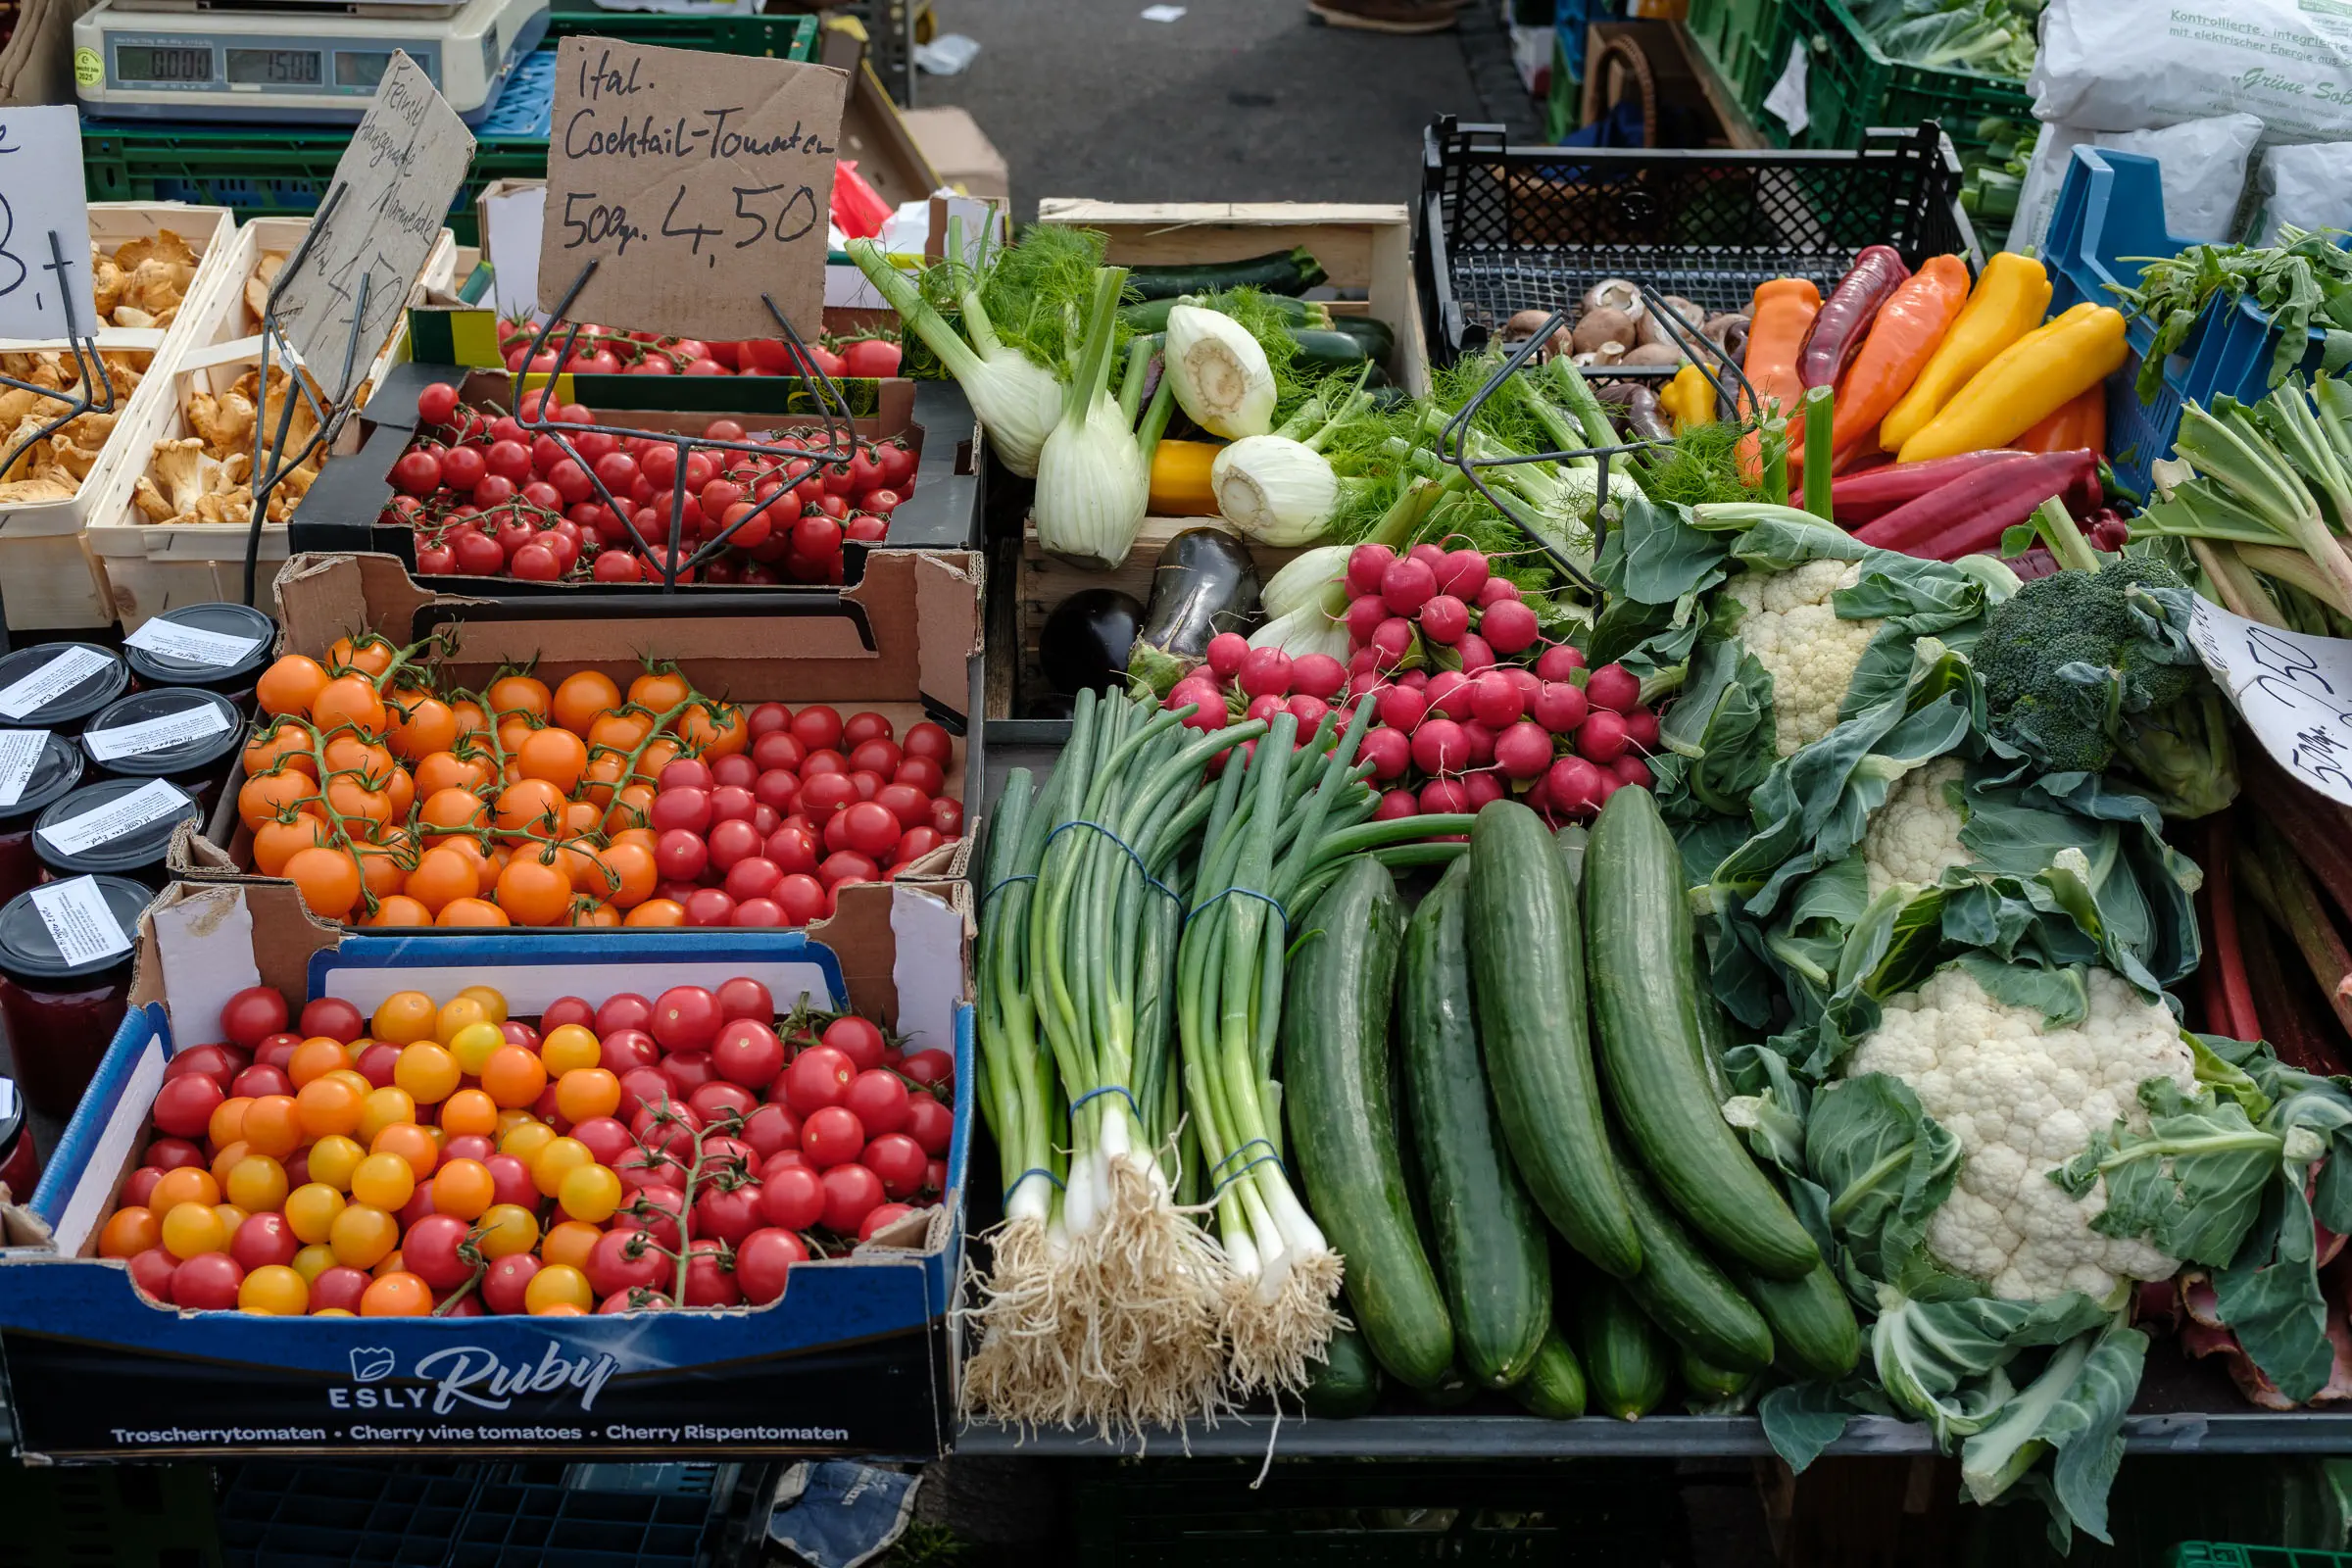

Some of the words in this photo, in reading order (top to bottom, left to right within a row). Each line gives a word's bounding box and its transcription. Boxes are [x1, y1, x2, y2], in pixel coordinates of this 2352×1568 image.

[2169, 26, 2190, 38] mit
[2193, 28, 2267, 52] elektrischer
[2270, 42, 2314, 62] Energie
[2317, 55, 2338, 66] aus
[2273, 27, 2349, 52] integrierte
[381, 65, 423, 127] Feinste
[368, 180, 435, 247] Marmelade
[661, 183, 818, 269] 4,50
[328, 1387, 427, 1409] ESLY
[414, 1340, 622, 1416] Ruby
[110, 1426, 327, 1445] Troscherrytomaten
[349, 1424, 424, 1443] Cherry
[427, 1424, 475, 1441] vine
[477, 1425, 582, 1441] tomatoes
[605, 1424, 681, 1443] Cherry
[684, 1424, 850, 1443] Rispentomaten
